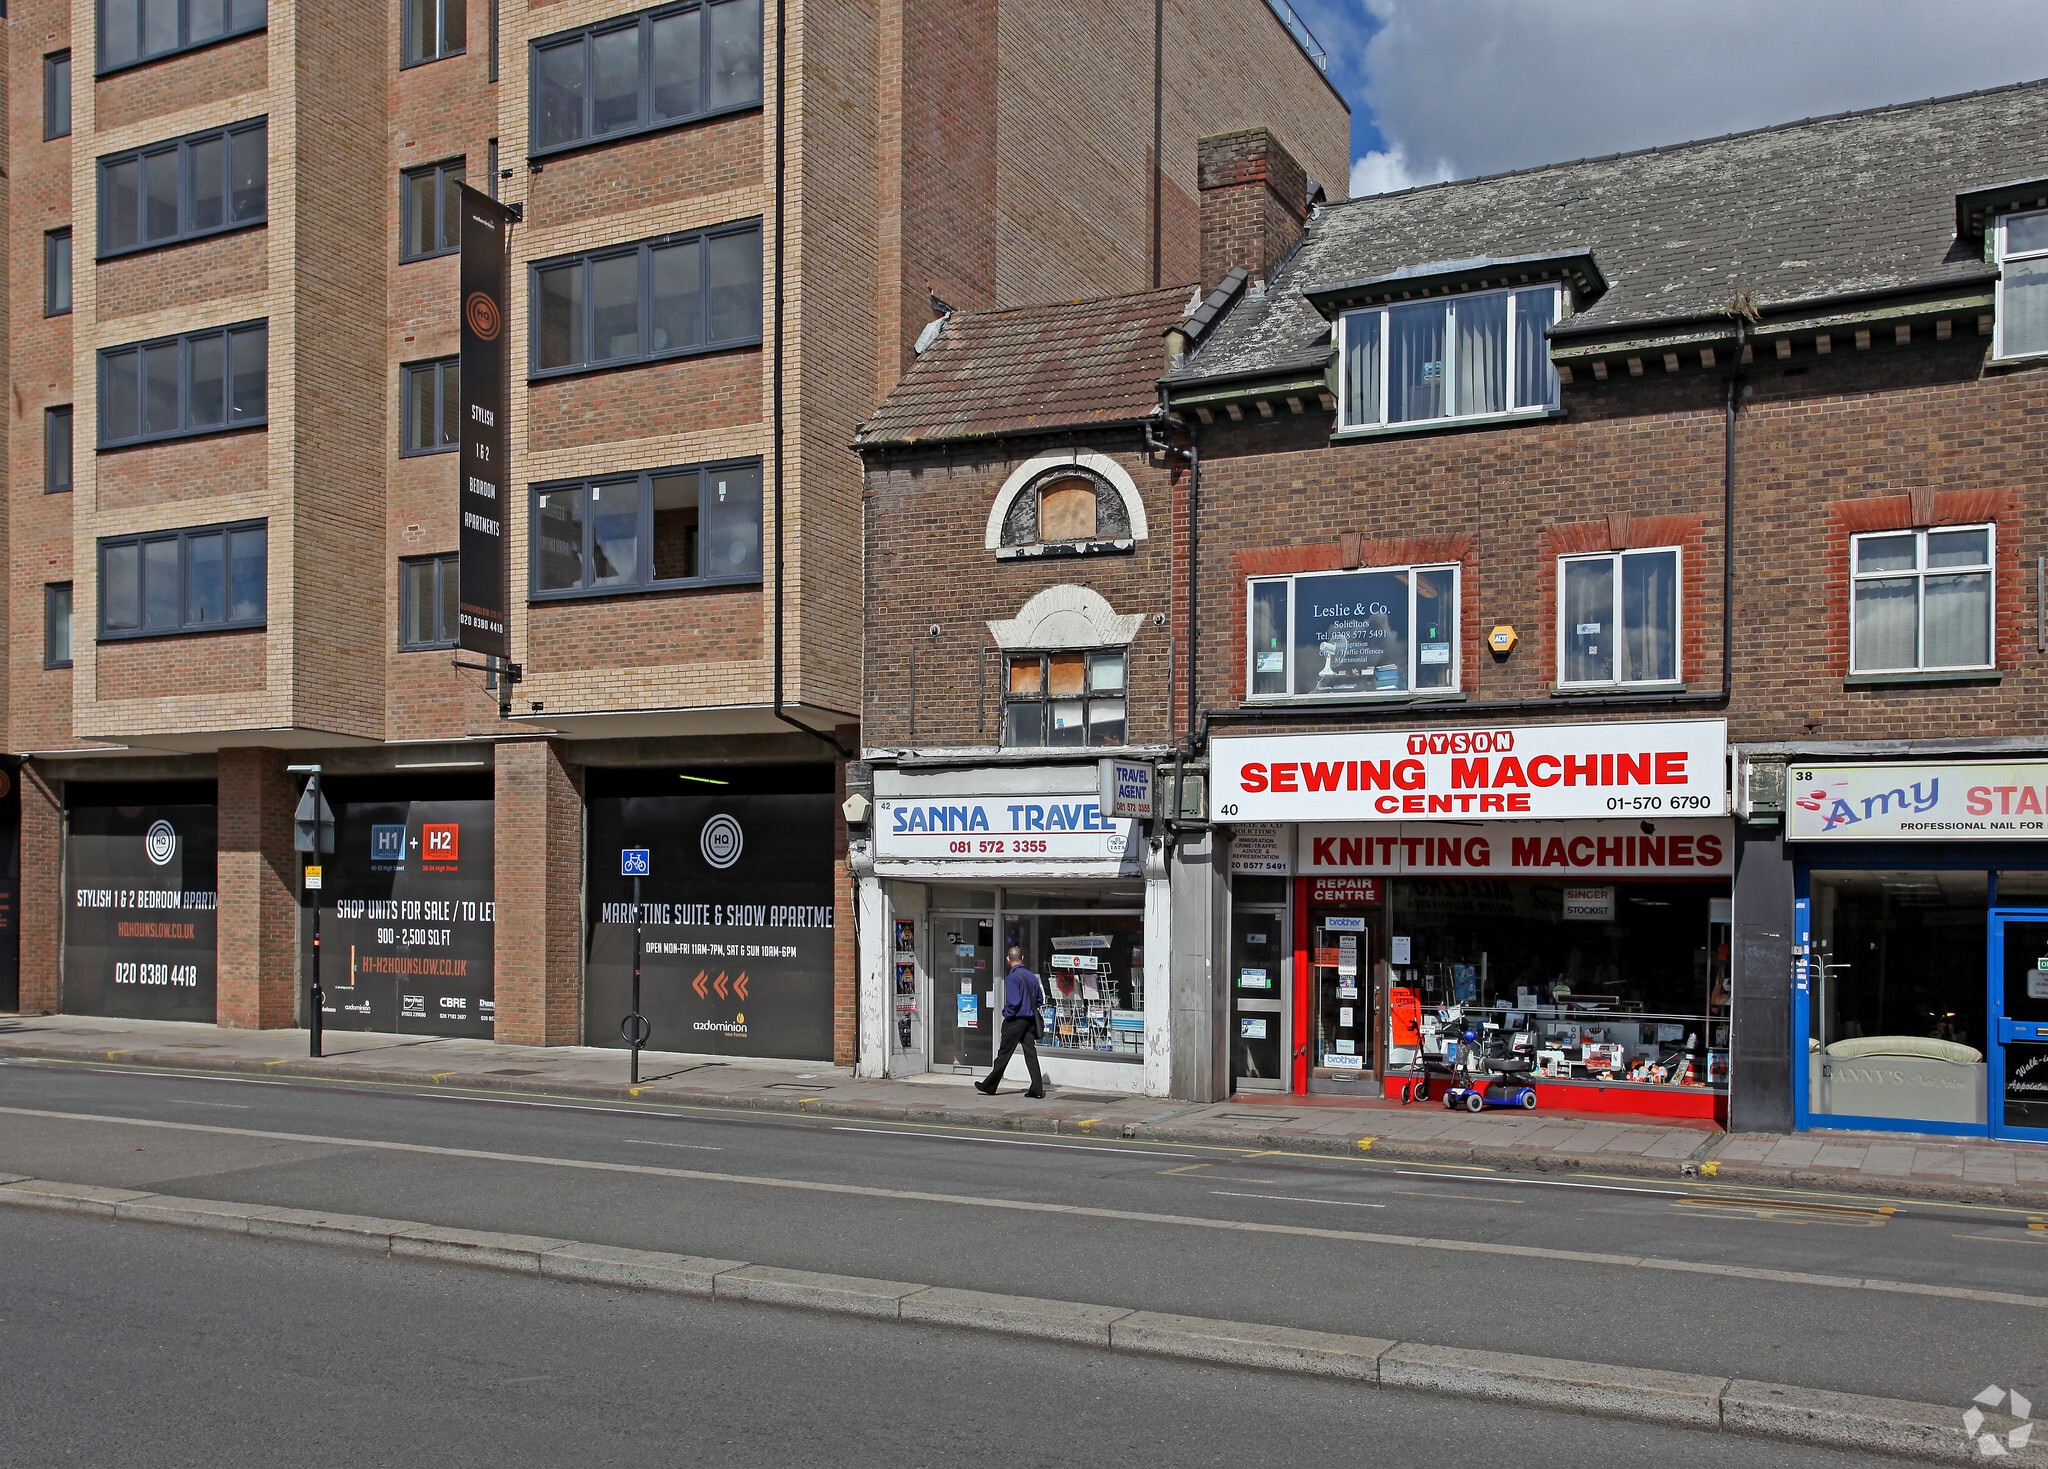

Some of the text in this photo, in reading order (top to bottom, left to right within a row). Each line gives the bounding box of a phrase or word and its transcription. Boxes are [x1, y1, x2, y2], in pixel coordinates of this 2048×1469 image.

[477, 308, 490, 321] HQ
[471, 404, 494, 427] STYLISH
[476, 442, 480, 458] 1
[485, 446, 490, 462] 2
[469, 476, 496, 500] BEDROOM
[464, 511, 500, 537] APARTMENTS
[1313, 602, 1391, 618] Leslie & Co.
[460, 613, 472, 626] 020
[474, 617, 488, 630] 8380
[1334, 620, 1370, 629] Solicitors
[1316, 632, 1330, 641] Tel.
[1352, 630, 1368, 639] 577
[1368, 630, 1388, 638] 5491
[1409, 732, 1512, 754] TYSON
[1116, 767, 1148, 784] TRAVEL
[1240, 752, 1688, 793] SEWING MACHINE
[1796, 772, 1813, 781] 38
[1118, 785, 1148, 800] AGENT
[880, 802, 891, 810] 42
[1116, 803, 1150, 813] 081 572 3355
[1220, 795, 1711, 816] 40 01-570 6790
[1374, 792, 1531, 814] CENTRE
[1822, 777, 2048, 832] Amy STA
[892, 804, 1116, 832] SANNA TRAVEL
[1900, 822, 2044, 830] PROFESSIONAL NAIL FOR
[156, 836, 166, 846] HQ
[379, 832, 398, 850] H1
[430, 832, 452, 850] H2
[714, 834, 730, 844] HQ
[950, 840, 1047, 854] 081 572 3355
[1312, 834, 1722, 868] KNITTING MACHINES
[1316, 878, 1372, 889] REPAIR
[77, 889, 112, 908] STYLISH
[114, 890, 118, 908] 1
[120, 890, 127, 908] &
[129, 890, 135, 908] 2
[138, 890, 181, 910] BEDROOM
[1314, 890, 1376, 900] CENTRE
[1567, 890, 1608, 900] SINGER
[337, 900, 496, 922] SHOP UNITS FOR SALE / TO LET
[674, 904, 710, 925] SUITE
[714, 904, 723, 926] &
[726, 904, 766, 927] SHOW
[1567, 905, 1610, 915] STOCKIST
[118, 922, 194, 939] HQHOUNSLOW.CO.UK
[1328, 918, 1362, 927] brother
[378, 928, 394, 944] 900
[402, 929, 426, 947] 2,500
[428, 930, 440, 946] SQ
[441, 930, 451, 946] FT
[646, 942, 662, 954] OPEN
[663, 942, 690, 955] MON-FRI
[727, 945, 739, 956] SAT
[740, 945, 745, 956] &
[747, 945, 760, 957] SUN
[761, 946, 797, 958] 10AM-6PM
[116, 962, 197, 987] 020 8380 4418
[362, 956, 467, 976] H1-H2HOUNSLOW.CO.UK
[440, 997, 466, 1008] CBRE
[1327, 1055, 1359, 1064] brother
[1822, 1064, 1904, 1086] DANNY'S
